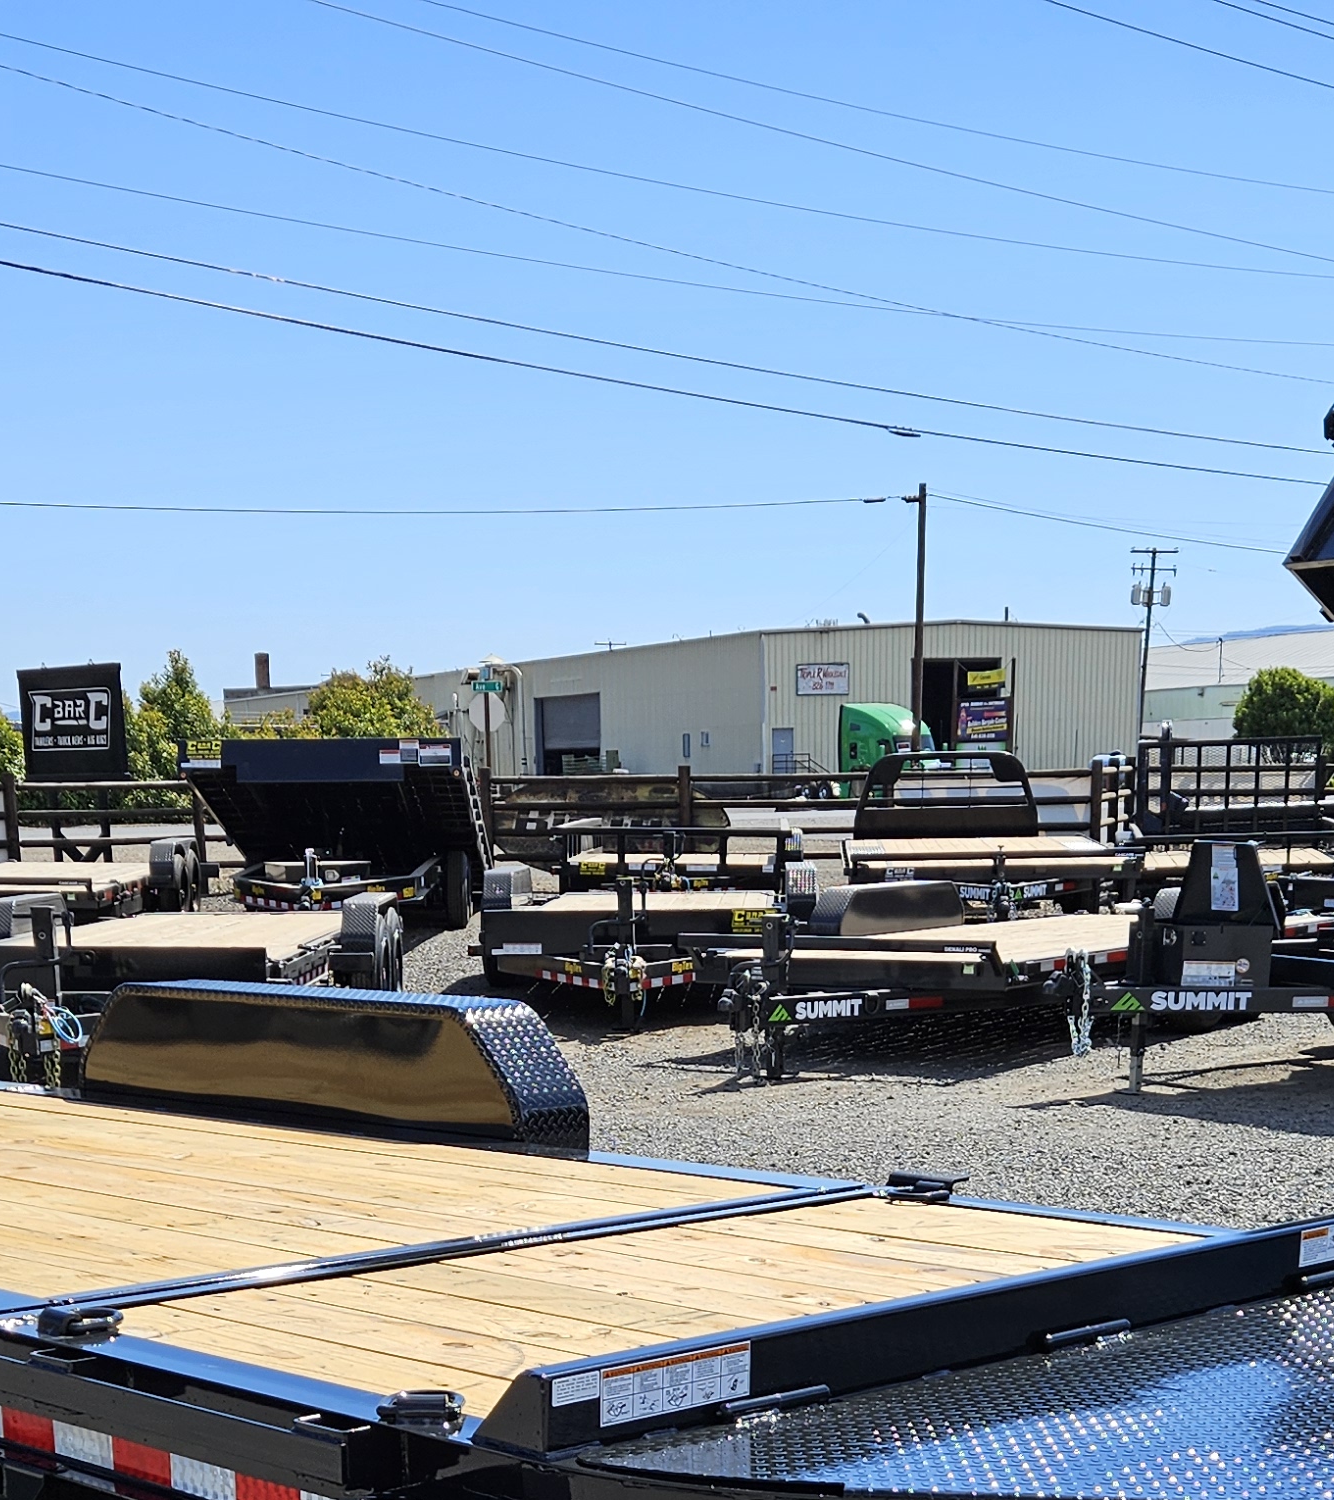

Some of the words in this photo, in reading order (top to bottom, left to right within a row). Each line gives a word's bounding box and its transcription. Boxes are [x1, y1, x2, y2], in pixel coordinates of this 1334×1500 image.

[32, 695, 52, 731] C
[53, 699, 85, 719] BAR
[86, 692, 107, 730] C
[960, 886, 991, 899] SUMMIT
[1023, 884, 1047, 897] SUMMIT
[795, 998, 862, 1020] SUMMIT
[1150, 991, 1252, 1011] SUMMIT
